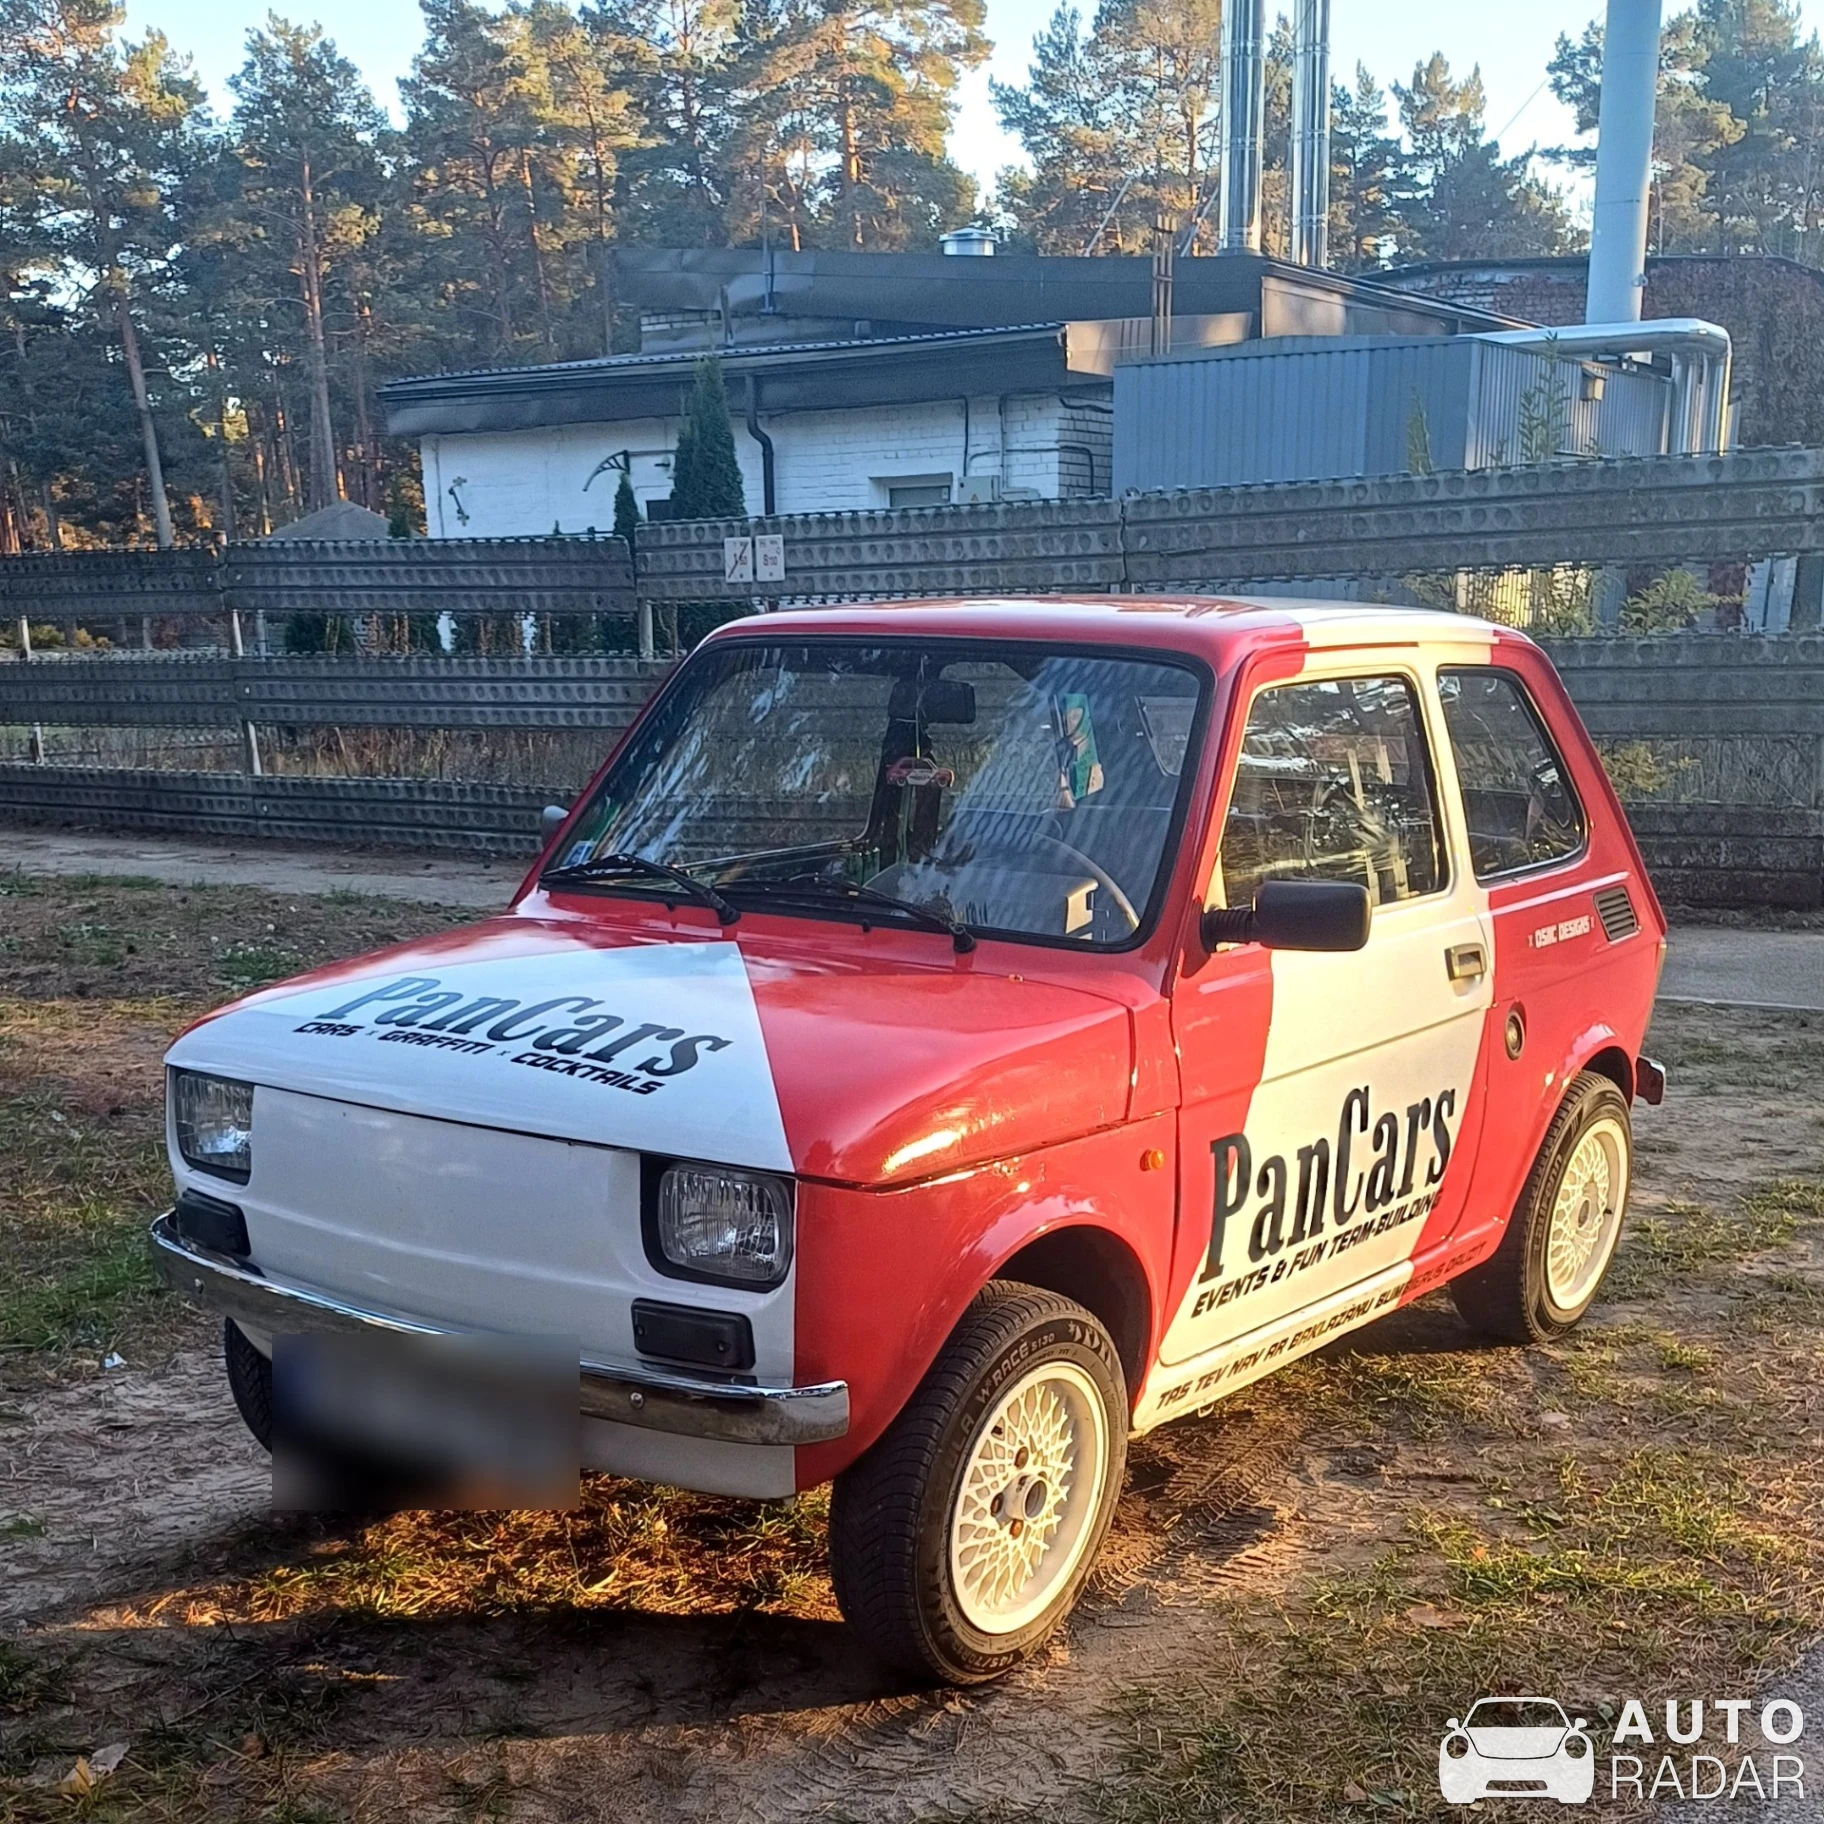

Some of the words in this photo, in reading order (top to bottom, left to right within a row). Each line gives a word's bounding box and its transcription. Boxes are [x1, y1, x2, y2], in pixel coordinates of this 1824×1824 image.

[293, 1022, 365, 1038] CARS
[379, 1030, 496, 1054] GRAFFITI
[511, 1052, 666, 1095] COCKTAILS
[315, 976, 734, 1077] PanCars
[1198, 1085, 1455, 1284] PanCars
[1191, 1266, 1270, 1318] EVENTS
[1271, 1259, 1288, 1283] &
[1288, 1240, 1327, 1280] FUN
[1328, 1189, 1444, 1260] TEAM-BUILDING
[1156, 1380, 1193, 1410] TAS
[1195, 1365, 1229, 1392] TEV
[1227, 1349, 1266, 1378] NAV
[1264, 1337, 1291, 1362] AR
